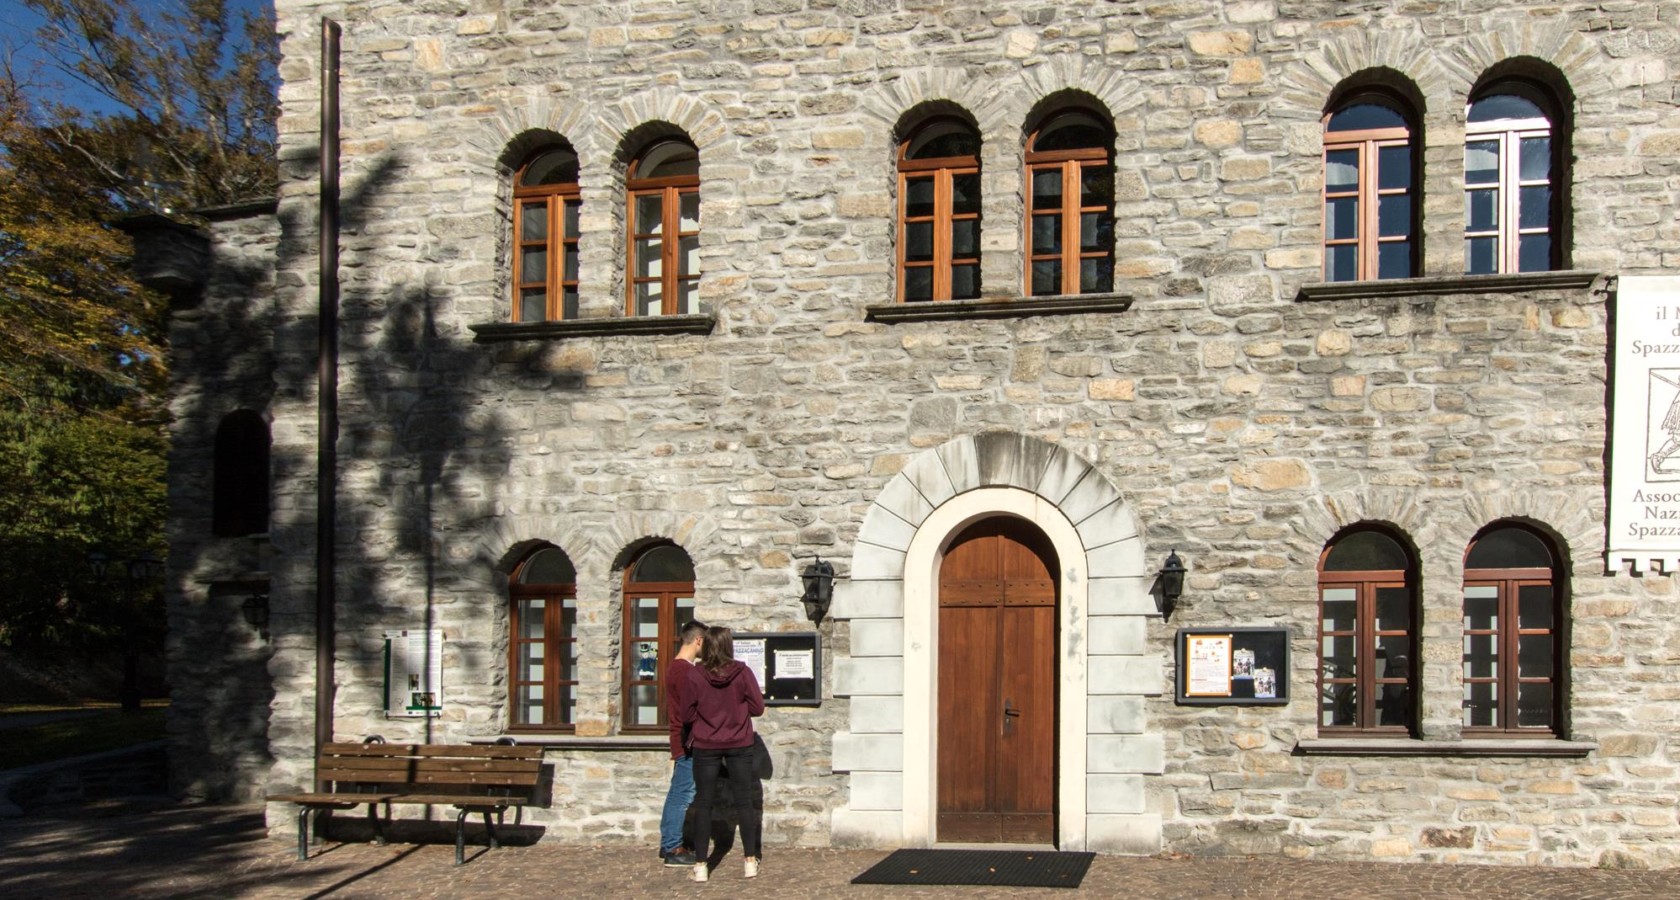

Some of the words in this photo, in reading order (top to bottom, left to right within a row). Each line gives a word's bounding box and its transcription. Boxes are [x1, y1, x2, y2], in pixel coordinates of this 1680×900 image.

[1656, 305, 1667, 320] il
[1632, 340, 1680, 358] Spazz
[1632, 489, 1680, 503] Assoc
[1644, 505, 1680, 519] Naz
